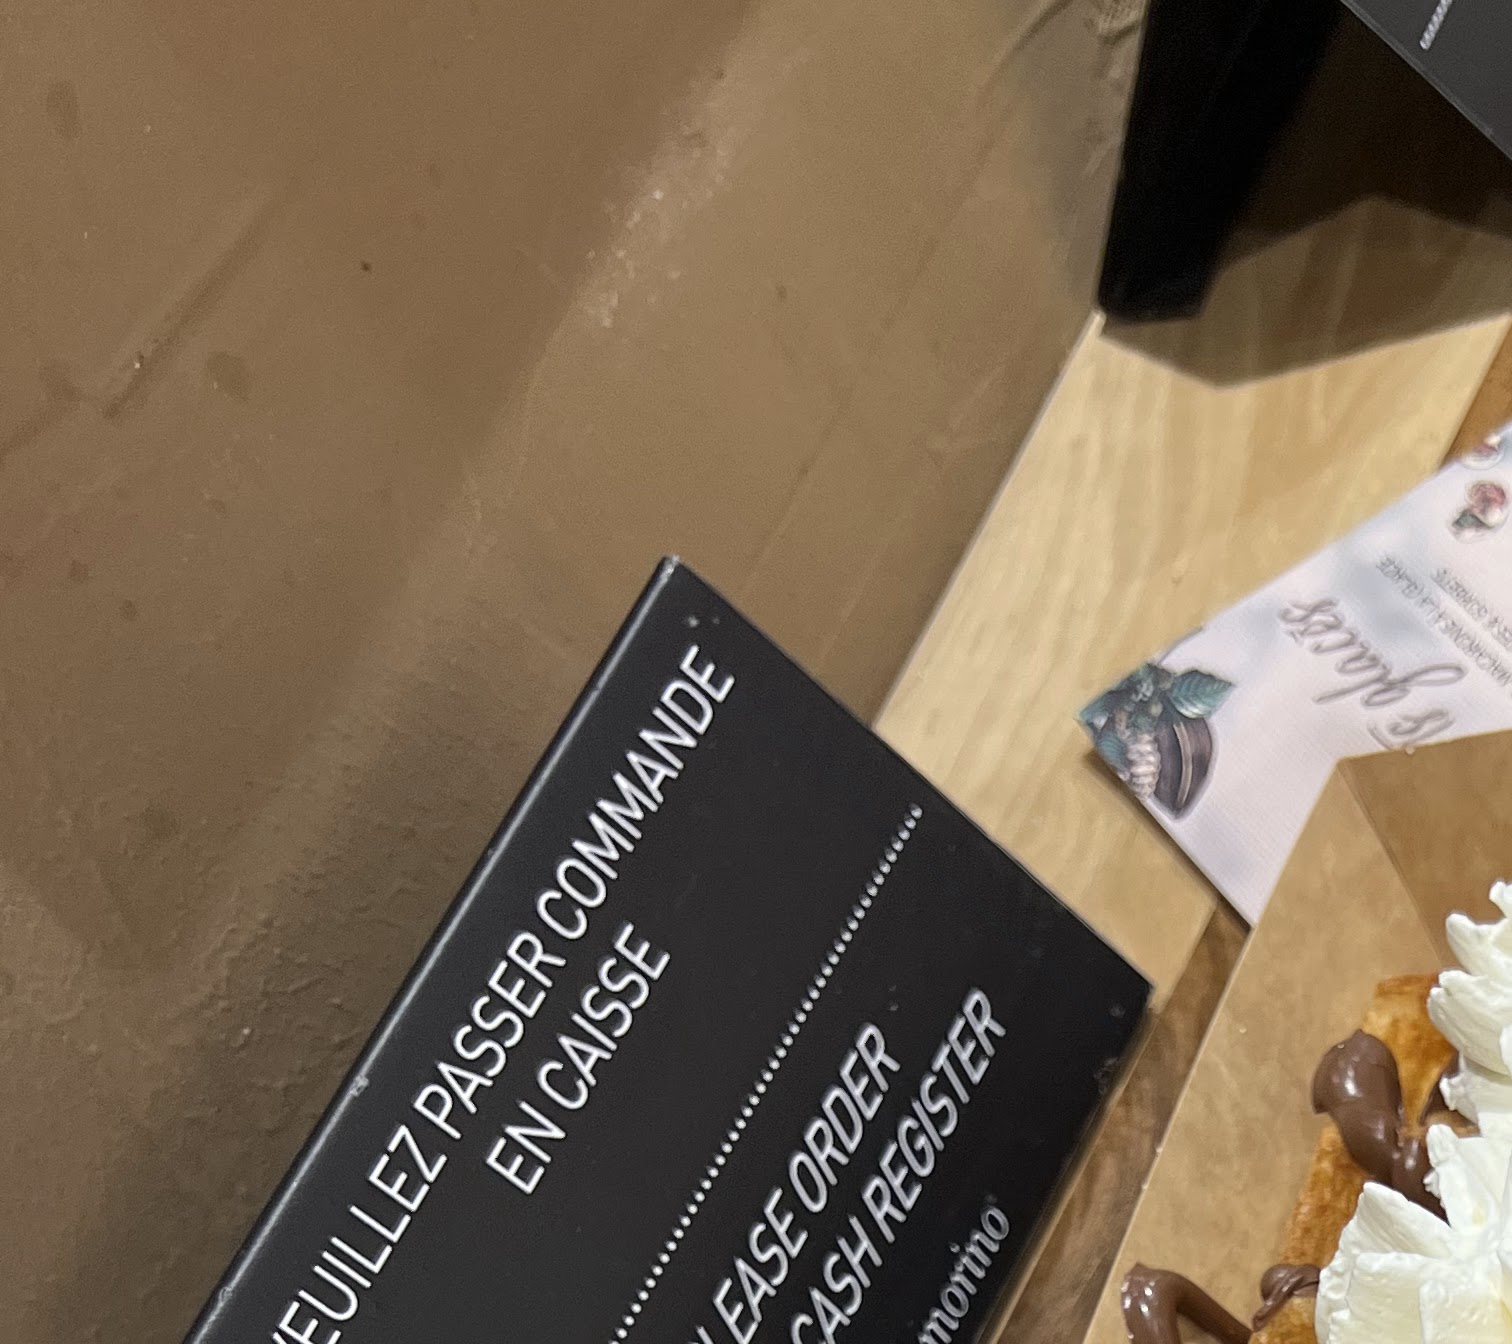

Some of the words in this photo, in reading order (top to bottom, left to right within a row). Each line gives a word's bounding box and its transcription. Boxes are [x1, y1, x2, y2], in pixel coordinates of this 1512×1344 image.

[413, 931, 567, 1140] PASSER
[536, 644, 735, 940] COMMANDE
[486, 1101, 566, 1194] EN
[537, 923, 671, 1110] CAISSE
[789, 1023, 902, 1210] ORDER
[849, 989, 1007, 1243] REGISTER
